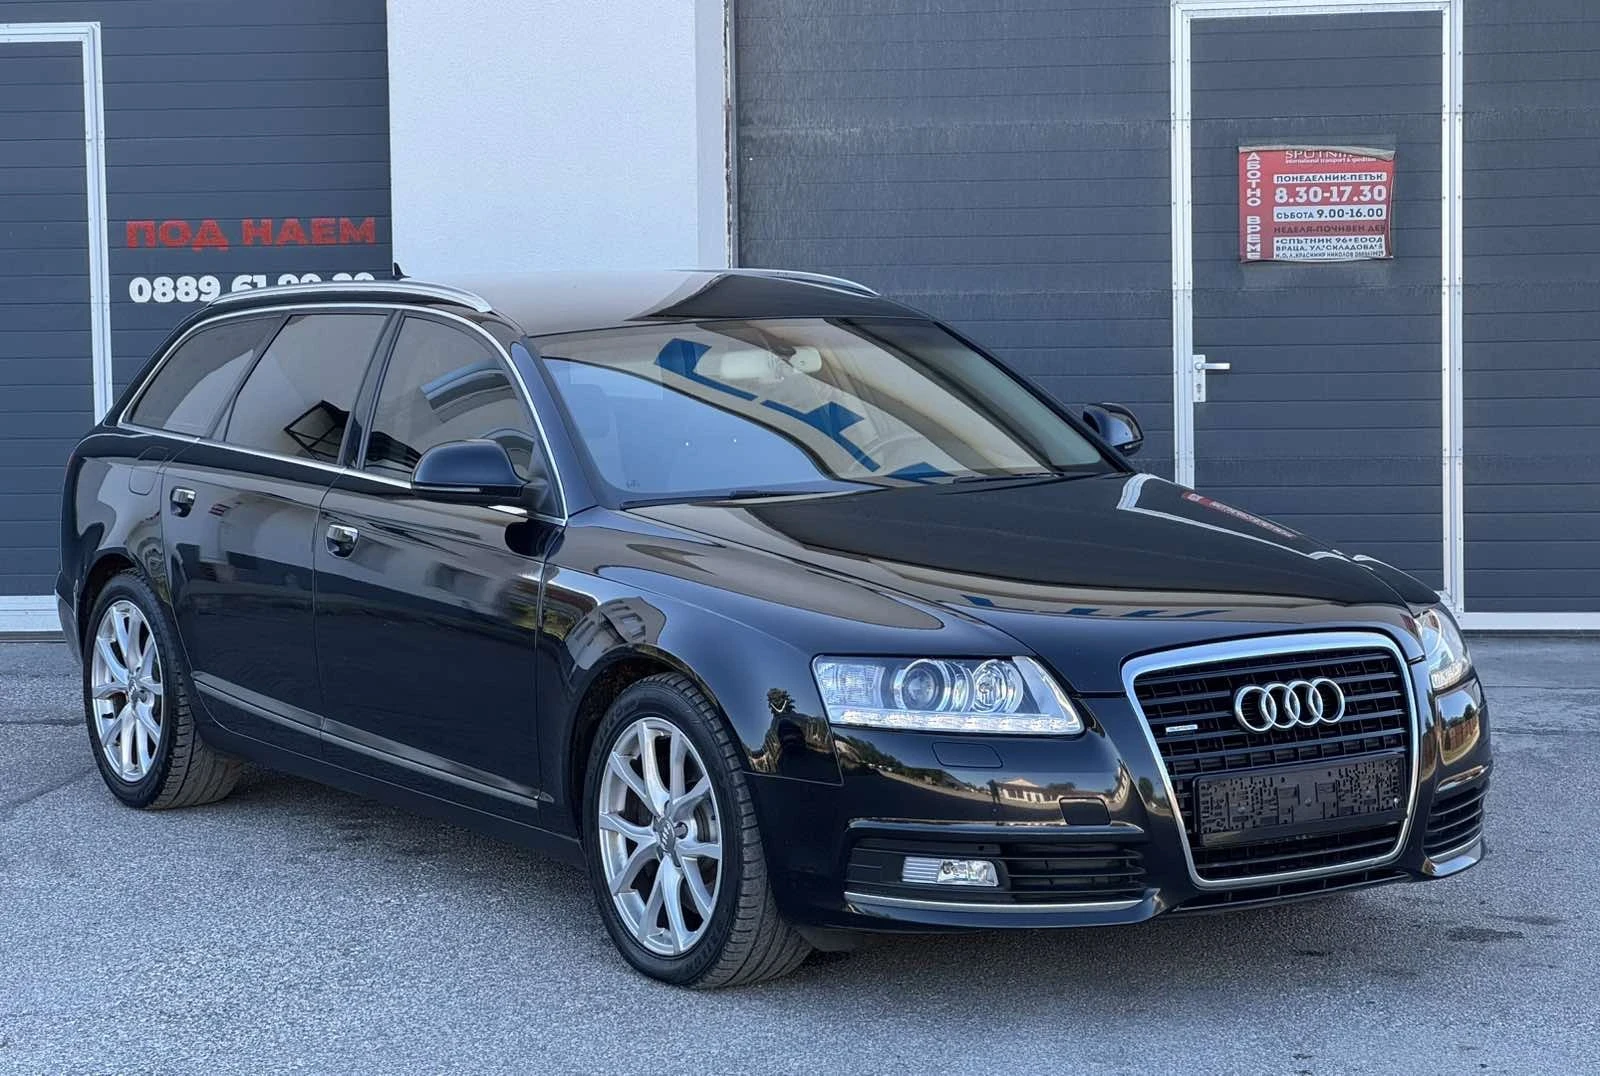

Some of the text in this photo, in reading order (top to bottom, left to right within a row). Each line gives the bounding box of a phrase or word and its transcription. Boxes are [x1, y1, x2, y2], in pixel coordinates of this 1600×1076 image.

[1276, 173, 1383, 183] ПОНЕДЕЛНИК-ПЕТЪК
[1274, 185, 1387, 203] 8.30-17.30
[1276, 208, 1383, 219] СЪБОТА 9.00-16.00
[126, 216, 376, 253] ПОД НАЕМ
[128, 275, 221, 303] 0889
